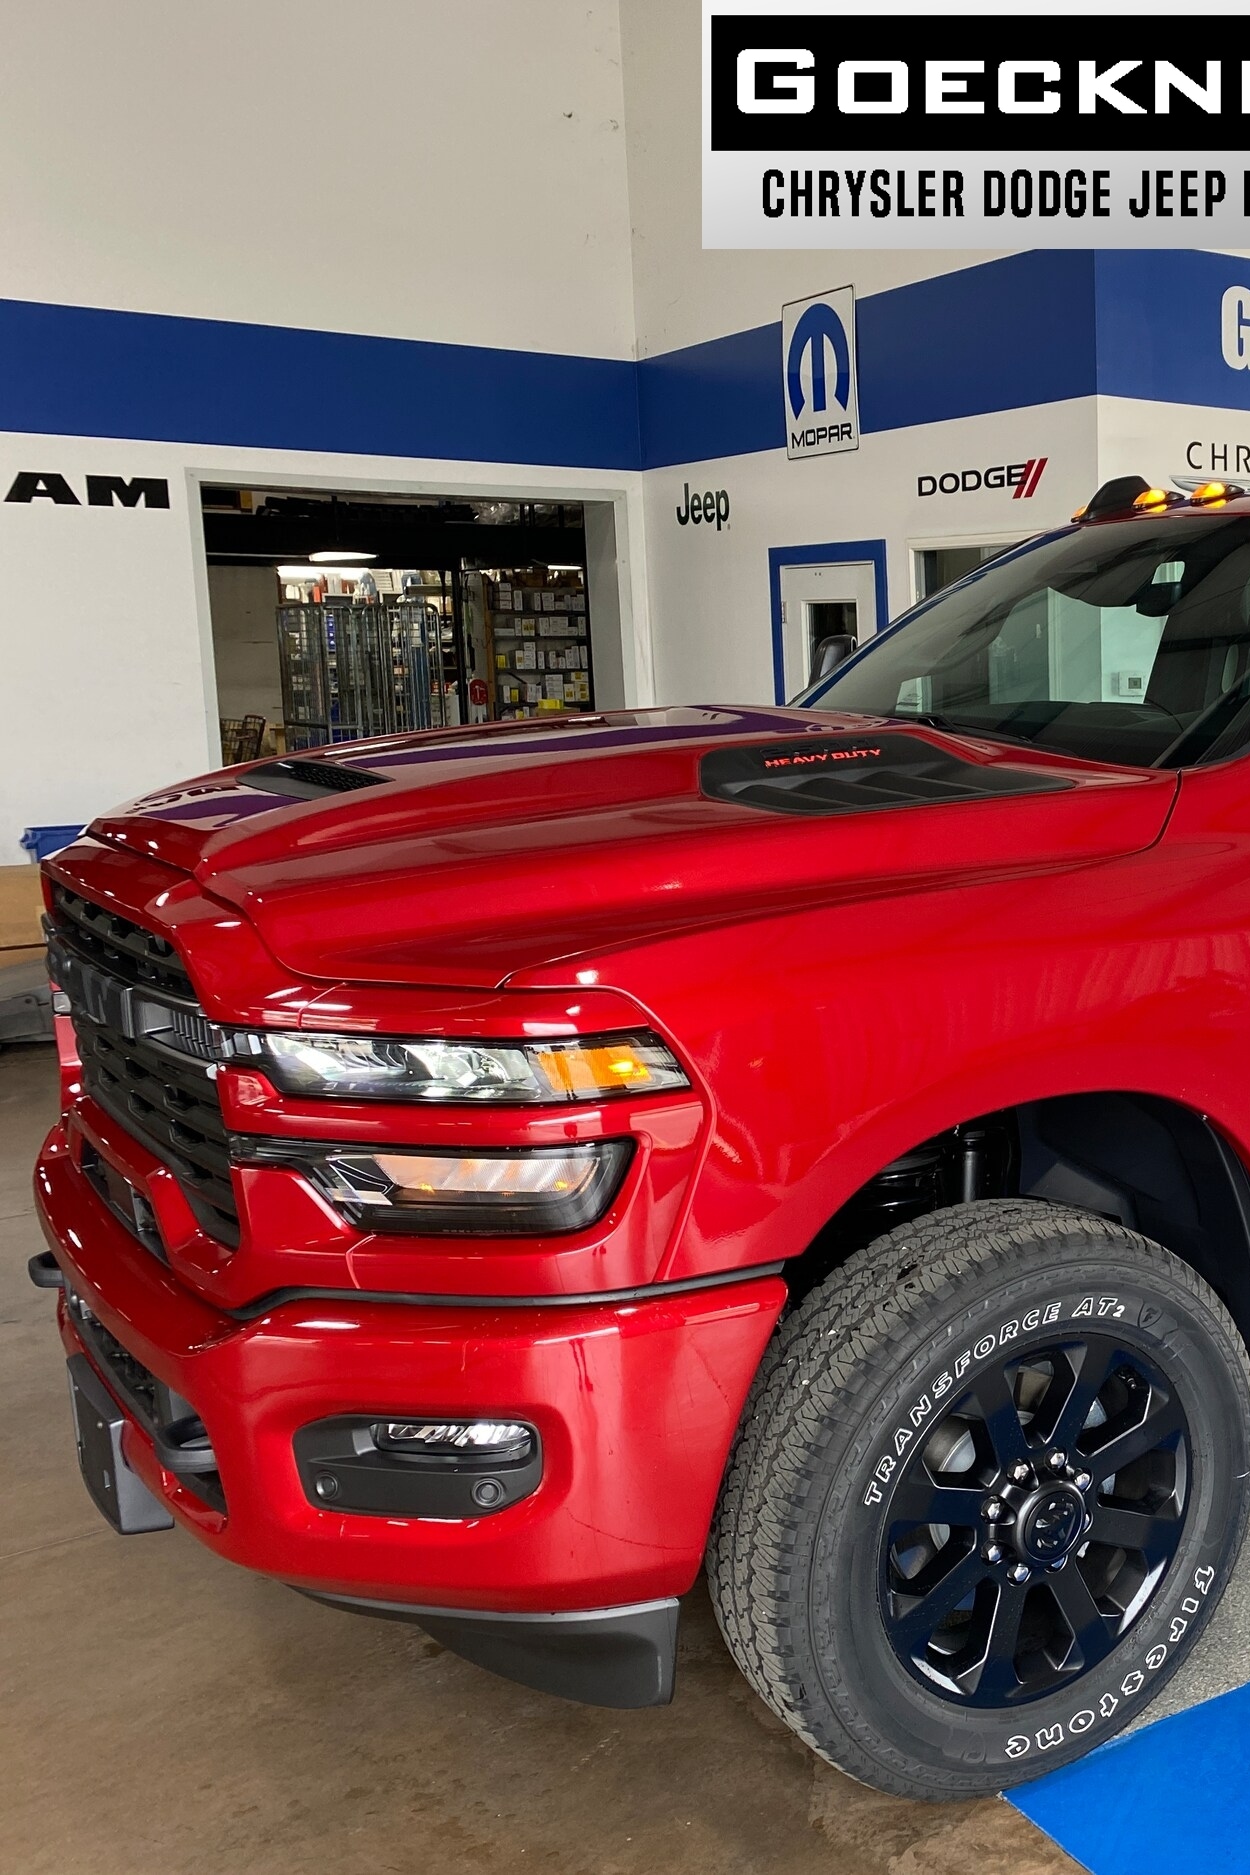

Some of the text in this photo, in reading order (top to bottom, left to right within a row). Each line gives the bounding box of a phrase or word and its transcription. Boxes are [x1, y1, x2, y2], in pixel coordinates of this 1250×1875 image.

[791, 422, 853, 449] MOPAR
[917, 463, 1030, 498] DODGE
[676, 482, 730, 531] Jeep
[764, 748, 881, 768] HEAVY DUTY
[864, 1302, 1062, 1506] TRANSFORCE
